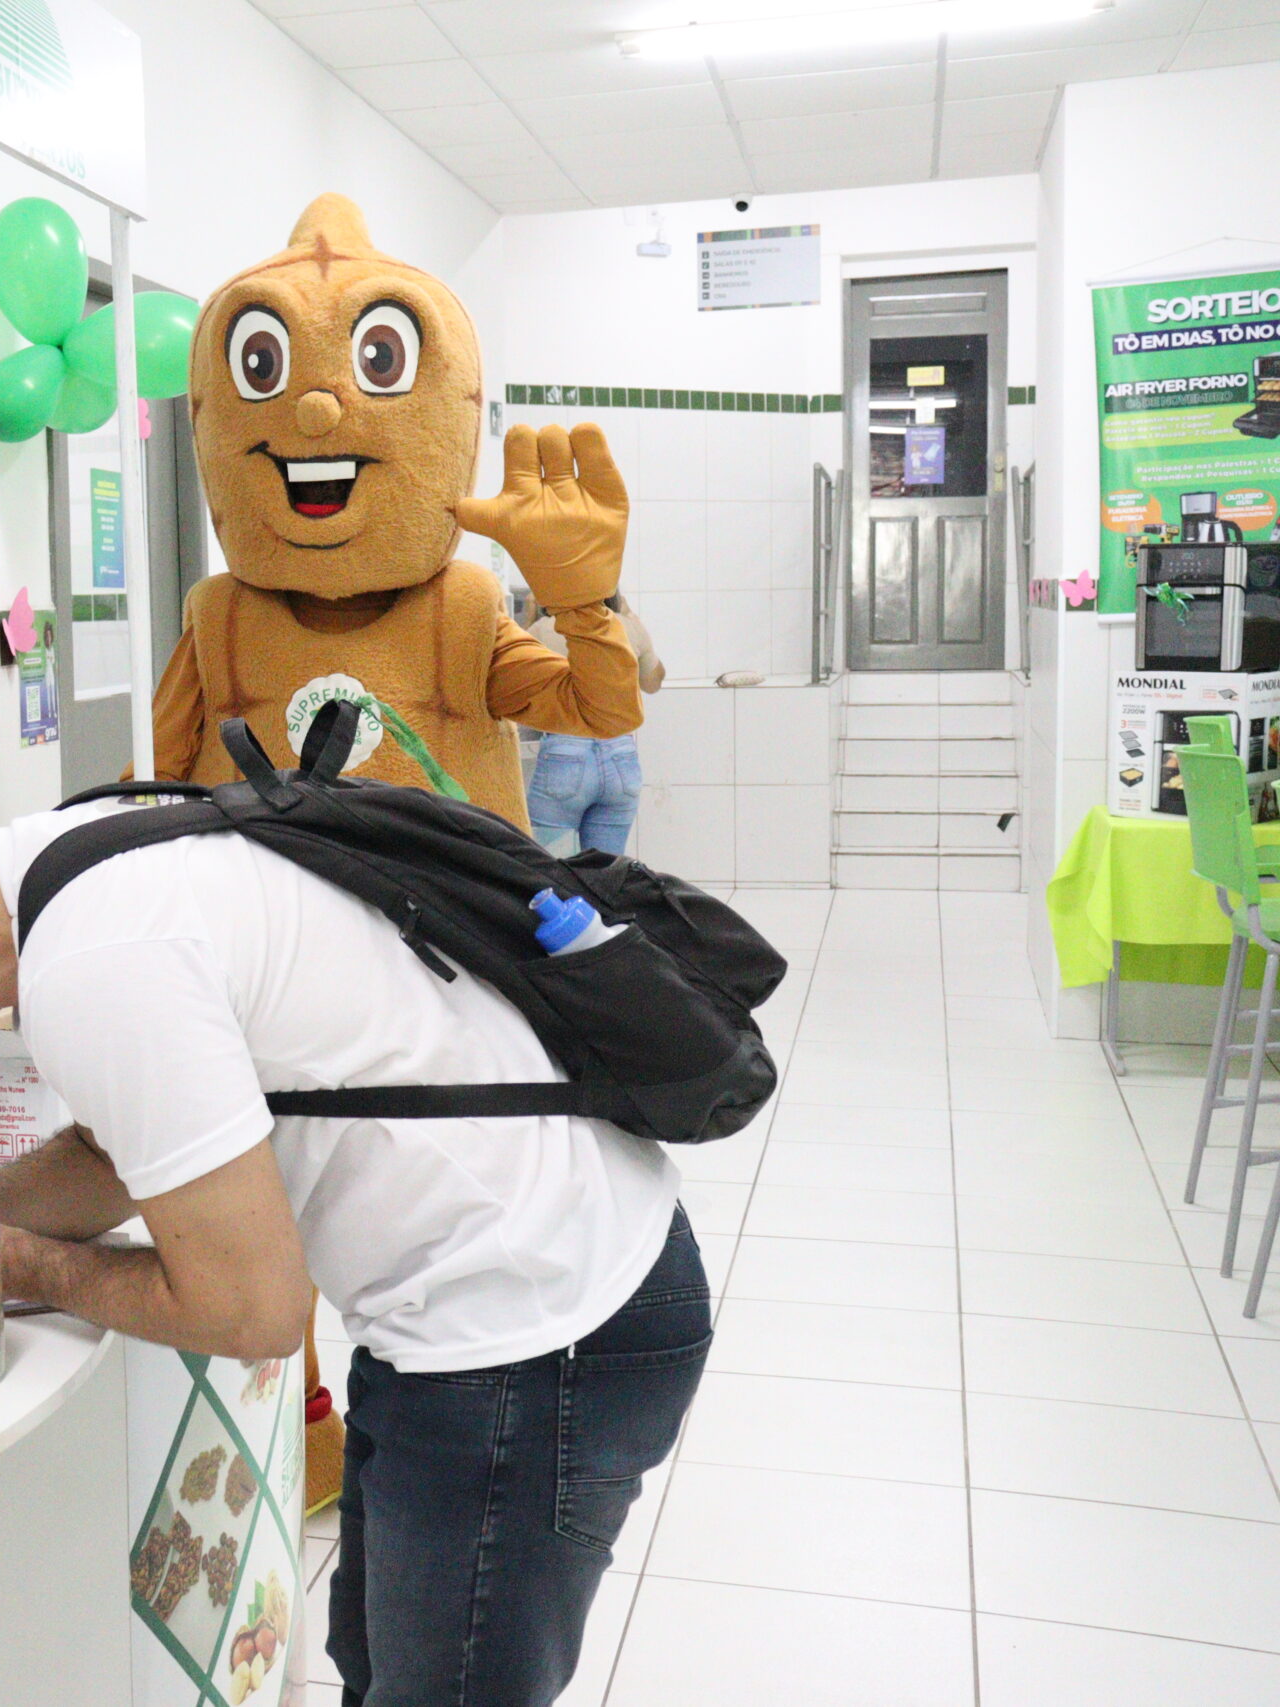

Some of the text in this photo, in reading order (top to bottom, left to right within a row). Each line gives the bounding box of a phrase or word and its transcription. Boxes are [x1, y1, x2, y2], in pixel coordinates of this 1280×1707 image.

[1147, 288, 1280, 324] SORTEIO
[1114, 333, 1140, 352] TÔ
[1141, 334, 1169, 349] EM
[1171, 329, 1217, 347] DIAS,
[1218, 324, 1243, 342] TÔ
[1245, 324, 1274, 341] NO
[1105, 373, 1248, 398] AIR FRYER FORNO
[1117, 677, 1187, 690] MONDIAL
